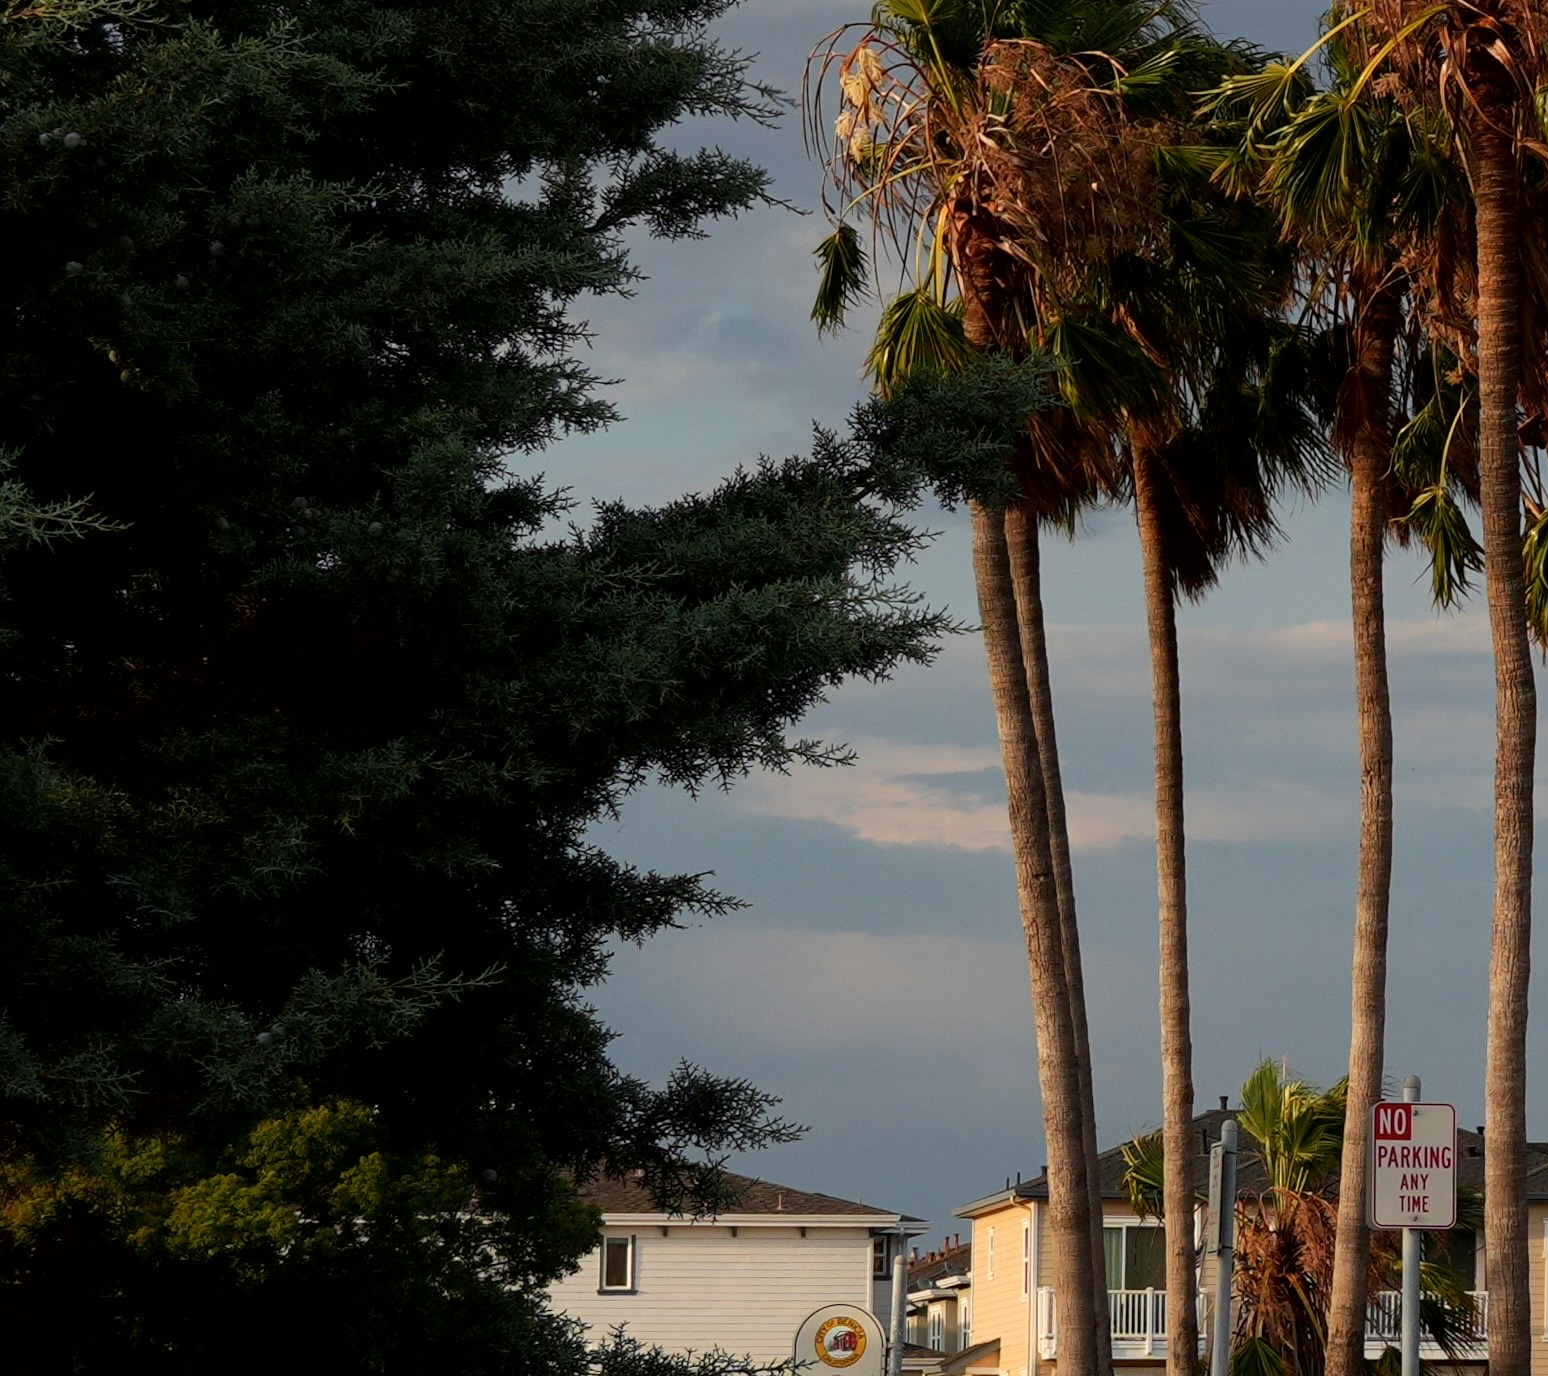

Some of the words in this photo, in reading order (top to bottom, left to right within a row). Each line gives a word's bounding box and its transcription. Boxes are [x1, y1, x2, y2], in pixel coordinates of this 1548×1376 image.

[1379, 1108, 1407, 1135] NO
[1377, 1145, 1452, 1169] PARKING
[1400, 1174, 1429, 1191] ANY
[1399, 1195, 1430, 1213] TIME
